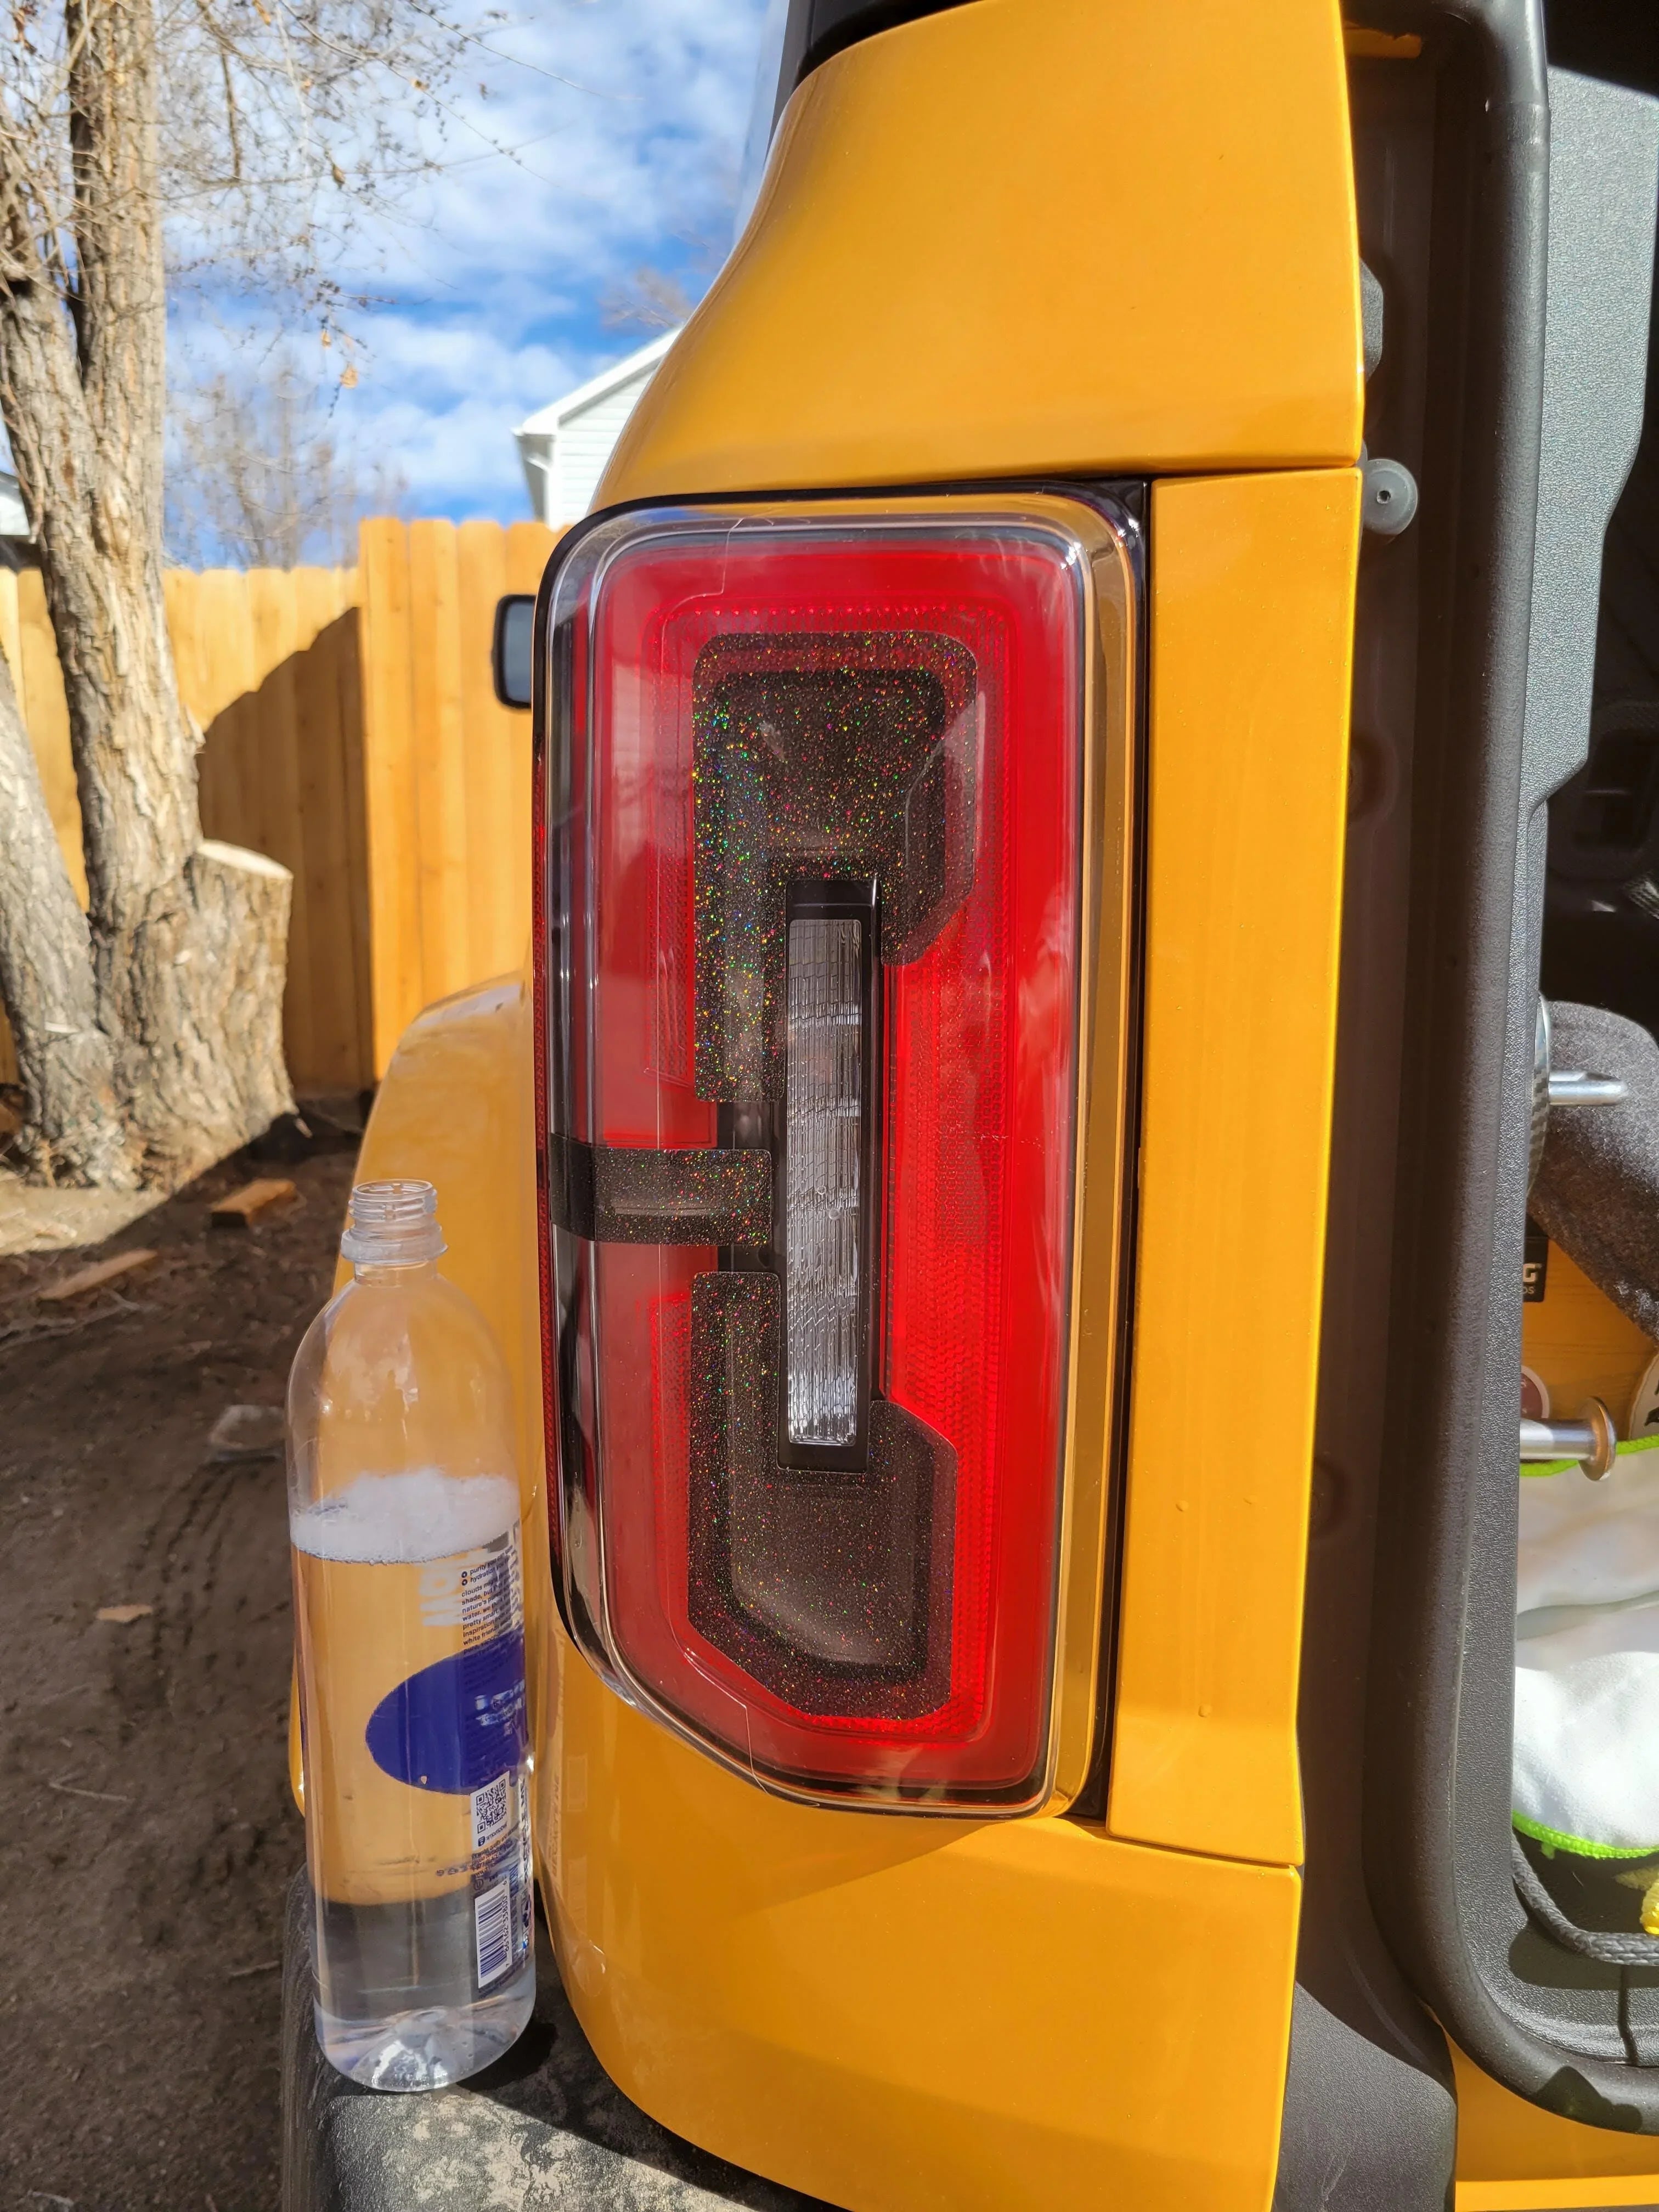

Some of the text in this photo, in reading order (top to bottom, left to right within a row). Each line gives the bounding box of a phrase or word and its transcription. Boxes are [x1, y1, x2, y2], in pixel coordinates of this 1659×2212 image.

[470, 1564, 486, 1576] purity
[471, 1567, 496, 1583] hydration
[462, 1585, 483, 1598] clouds
[462, 1594, 483, 1605] shade,
[484, 1587, 493, 1596] but
[462, 1599, 487, 1613] nature's
[463, 1611, 482, 1622] water.
[463, 1618, 482, 1631] pretty
[464, 1620, 495, 1638] inspiration
[464, 1635, 481, 1645] white
